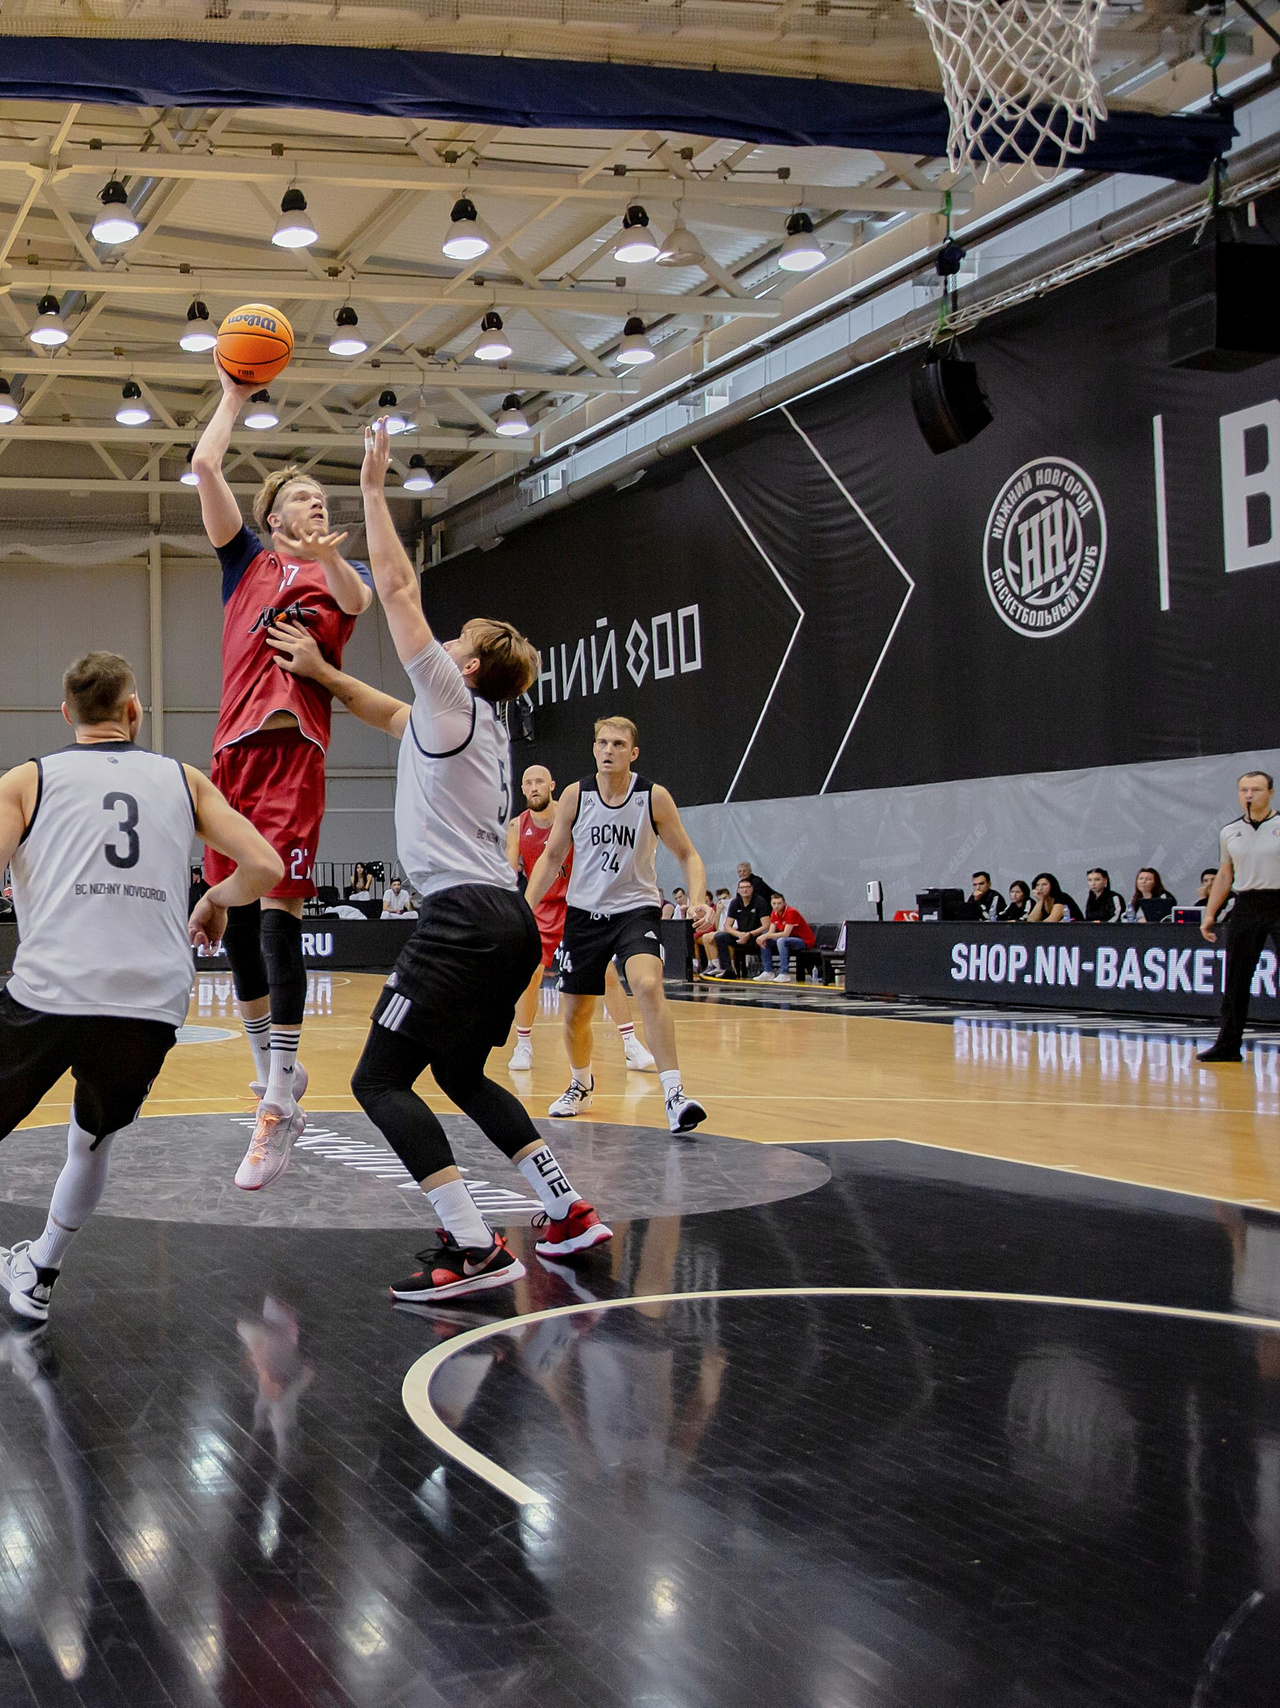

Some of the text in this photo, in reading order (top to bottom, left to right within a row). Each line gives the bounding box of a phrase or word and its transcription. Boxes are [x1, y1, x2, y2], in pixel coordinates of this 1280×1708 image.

[228, 314, 277, 333] Wilson
[991, 468, 1093, 540] НИЖНИЙ НОВГОРОД
[991, 545, 1098, 627] БАСКЕТБОЛЬНЫЙ КЛУБ
[624, 603, 702, 688] 800
[103, 791, 140, 869] 3
[590, 823, 636, 850] BCNN
[600, 850, 620, 874] 24
[75, 883, 167, 902] BC NIZHNY NOVGOROD
